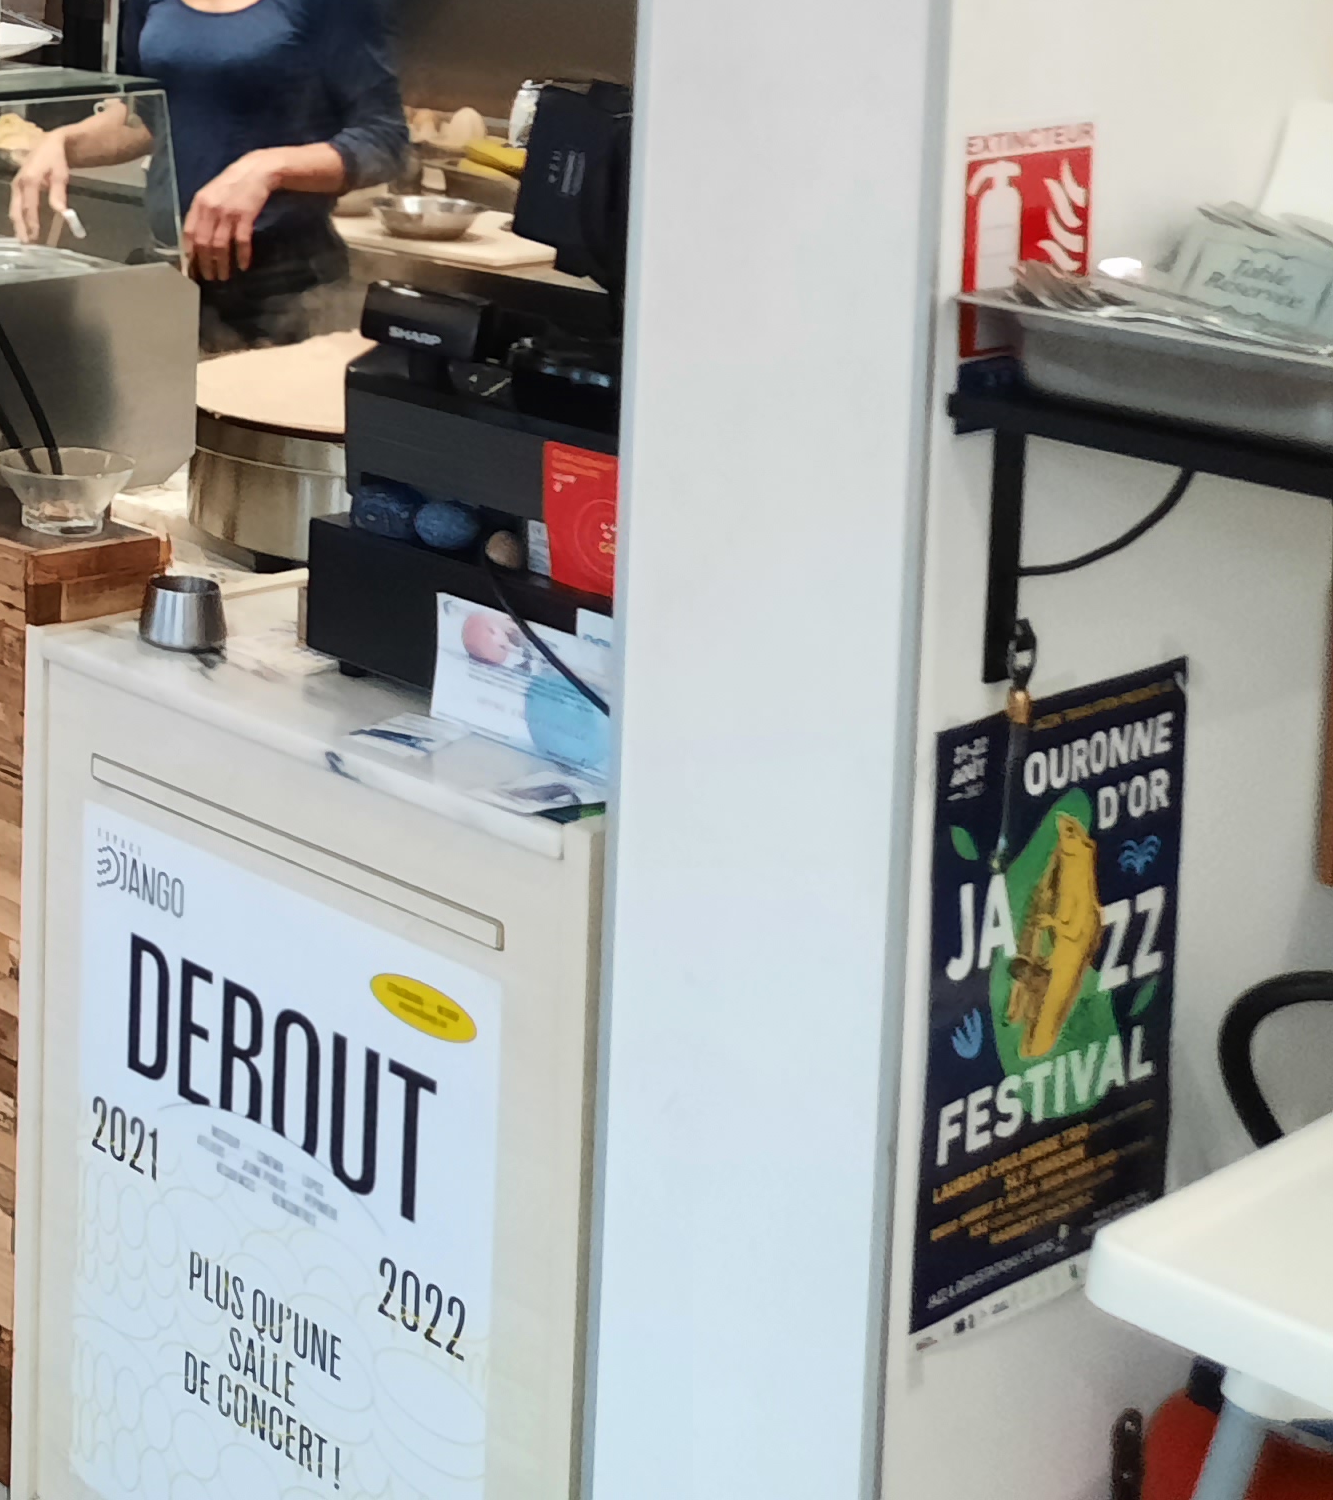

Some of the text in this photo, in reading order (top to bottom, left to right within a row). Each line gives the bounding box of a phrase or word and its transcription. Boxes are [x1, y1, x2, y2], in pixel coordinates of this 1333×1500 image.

[966, 121, 1094, 155] EXTINCTEUR
[1023, 711, 1174, 796] OURONNE
[1097, 768, 1171, 830] D'OR
[127, 931, 437, 1223] DEBOUT
[935, 1025, 1154, 1166] FESTIVAL
[92, 1095, 159, 1182] 2021
[188, 1249, 342, 1382] PLUS QU'UNE
[376, 1257, 466, 1362] 2022
[227, 1326, 296, 1408] SALLE
[183, 1350, 341, 1490] DE CONCERT !
